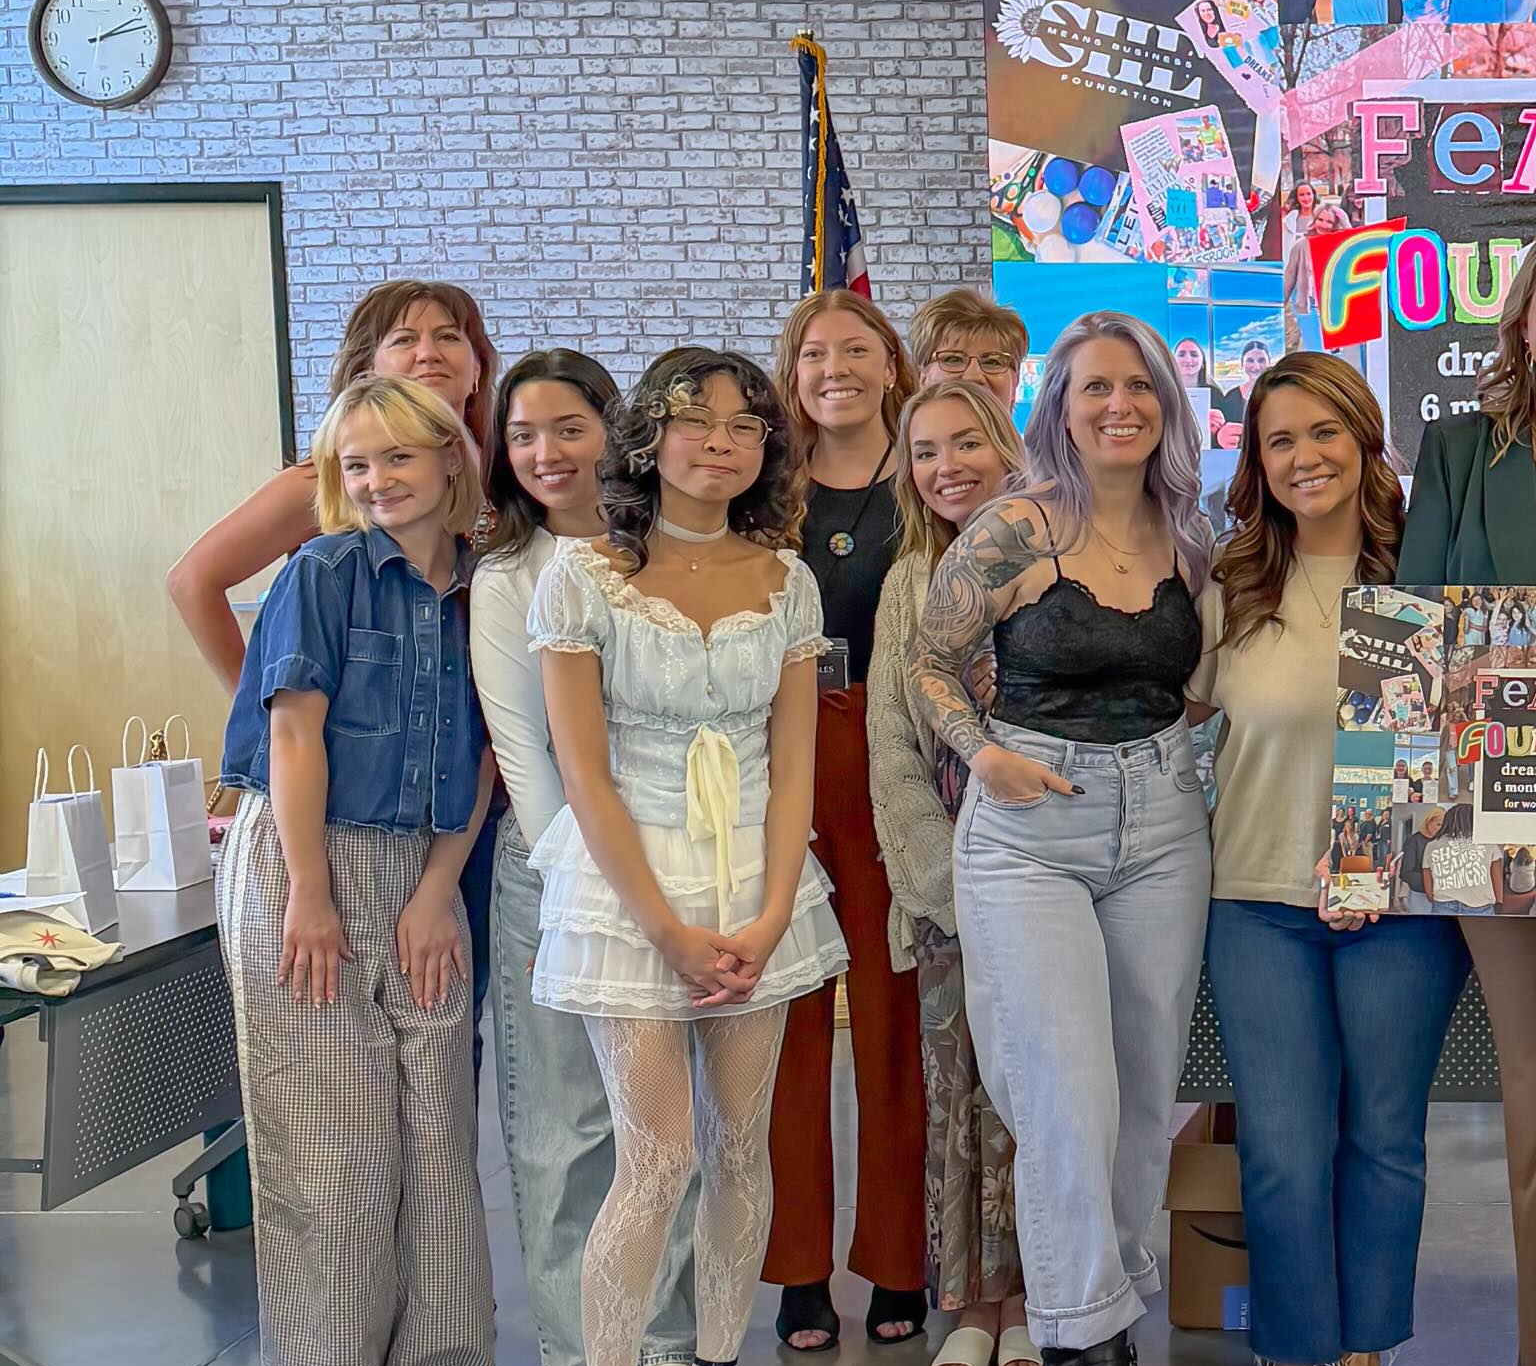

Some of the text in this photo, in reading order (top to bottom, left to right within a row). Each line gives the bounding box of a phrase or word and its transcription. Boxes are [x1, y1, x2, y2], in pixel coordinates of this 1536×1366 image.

[55, 8, 71, 24] 10
[132, 6, 143, 21] 2
[48, 31, 58, 47] 9
[143, 30, 153, 46] 3
[1047, 26, 1193, 70] MEANS BUSINESS
[59, 55, 69, 70] 8
[136, 53, 146, 68] 4
[78, 72, 87, 87] 7
[101, 77, 112, 92] 6
[122, 71, 132, 85] 5
[1060, 73, 1173, 108] FOUNDATION
[1420, 393, 1441, 422] 6
[1493, 781, 1502, 793] 6
[1504, 798, 1520, 809] for
